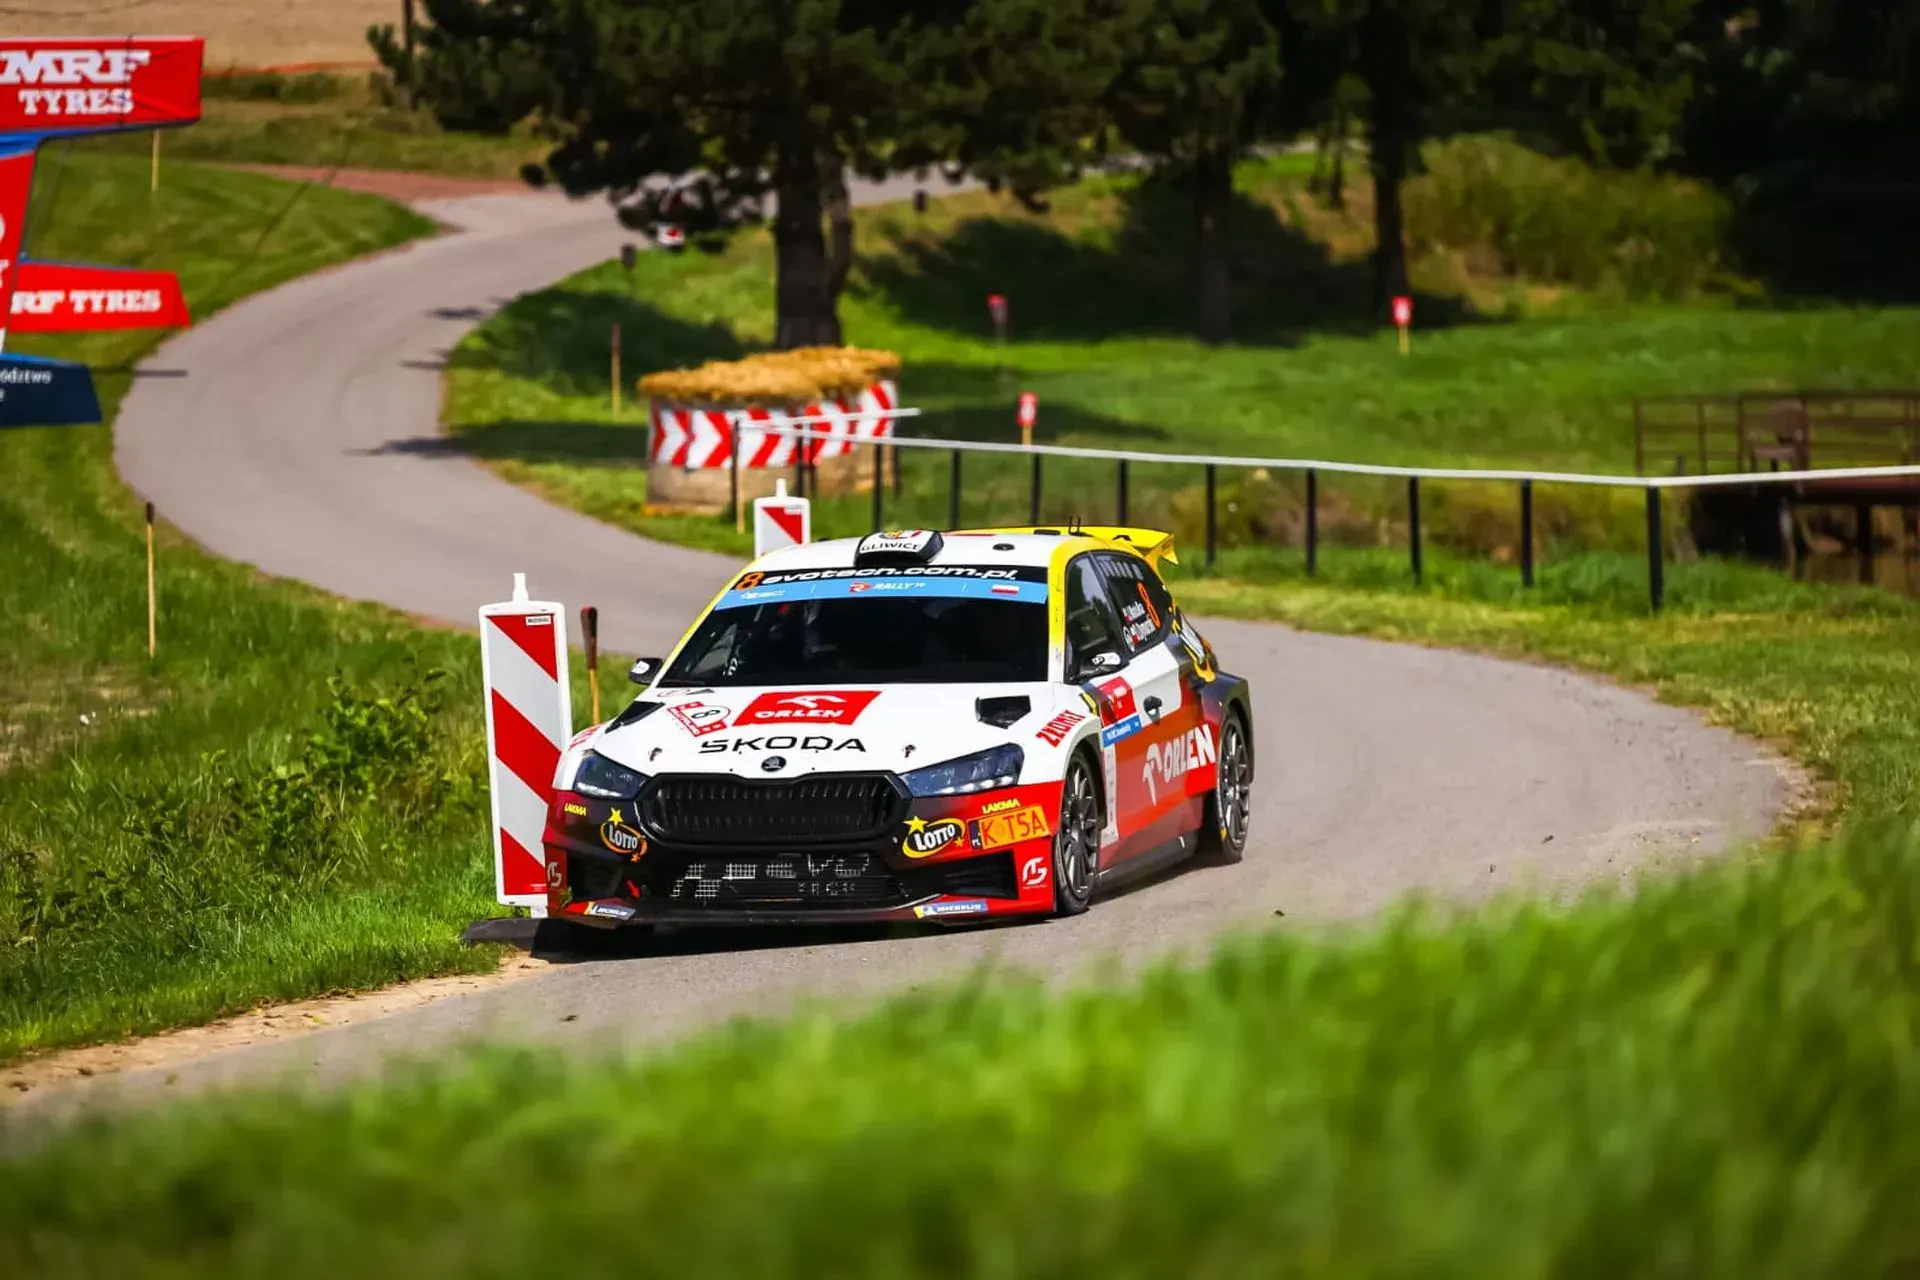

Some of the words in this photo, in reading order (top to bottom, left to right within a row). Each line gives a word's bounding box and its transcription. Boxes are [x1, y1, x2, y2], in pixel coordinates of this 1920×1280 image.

[0, 50, 151, 84] MRF
[18, 88, 134, 115] TYRES
[10, 290, 65, 314] RF
[69, 289, 161, 314] TYRES
[860, 542, 921, 551] GLIWICE
[735, 571, 765, 591] 8
[754, 709, 844, 719] ORLEN
[1163, 723, 1216, 784] ORLEN
[609, 823, 638, 849] LOTTO
[913, 824, 956, 851] LOTTO
